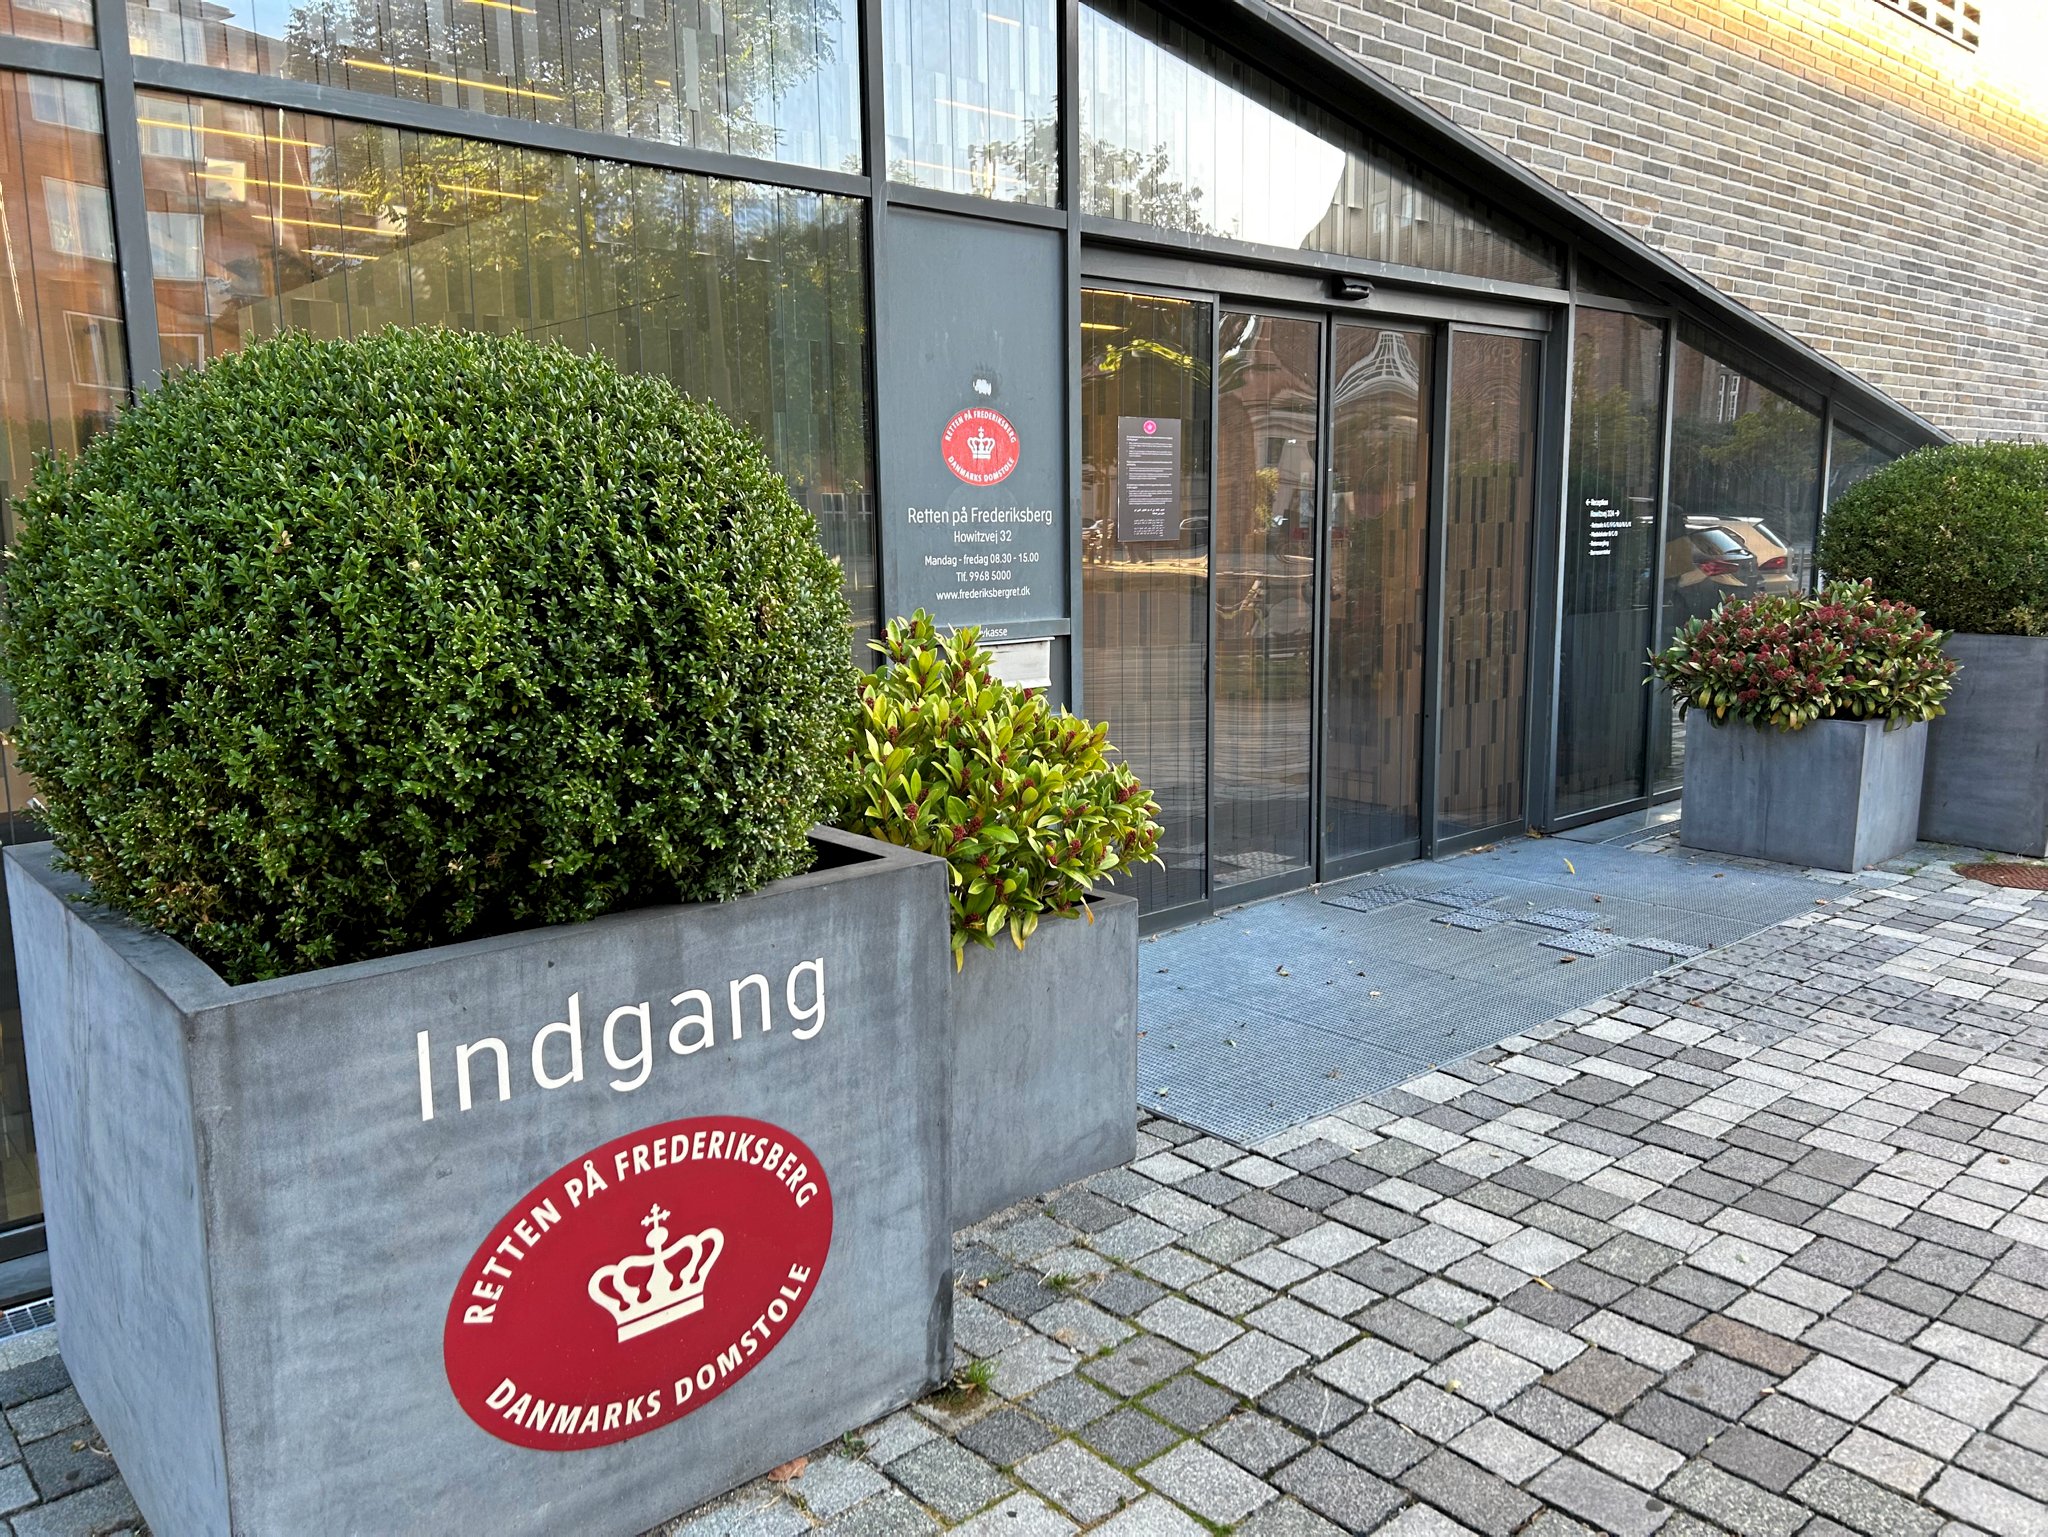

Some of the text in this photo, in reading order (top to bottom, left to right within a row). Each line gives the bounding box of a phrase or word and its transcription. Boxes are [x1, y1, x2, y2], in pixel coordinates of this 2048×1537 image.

[945, 409, 1017, 443] RETTEN PÅ FREDERIKSBERG
[947, 455, 1015, 482] DANMARKS DOMSTOLE
[907, 506, 1053, 526] Retten på Frederiksberg
[953, 529, 1012, 544] Howitzvej 32
[924, 555, 957, 567] Mandag
[963, 554, 989, 567] fredag
[989, 553, 1012, 564] 08.30
[1018, 552, 1040, 563] 15.00
[956, 570, 1012, 583] Tlf. 9968 5000
[936, 586, 1031, 601] www.frederiksbergret.dk
[416, 957, 827, 1122] Indgang
[463, 1129, 818, 1325] RETTEN PÅ FREDERIKSBERG
[485, 1261, 812, 1435] DANMARKS DOMSTOLE
